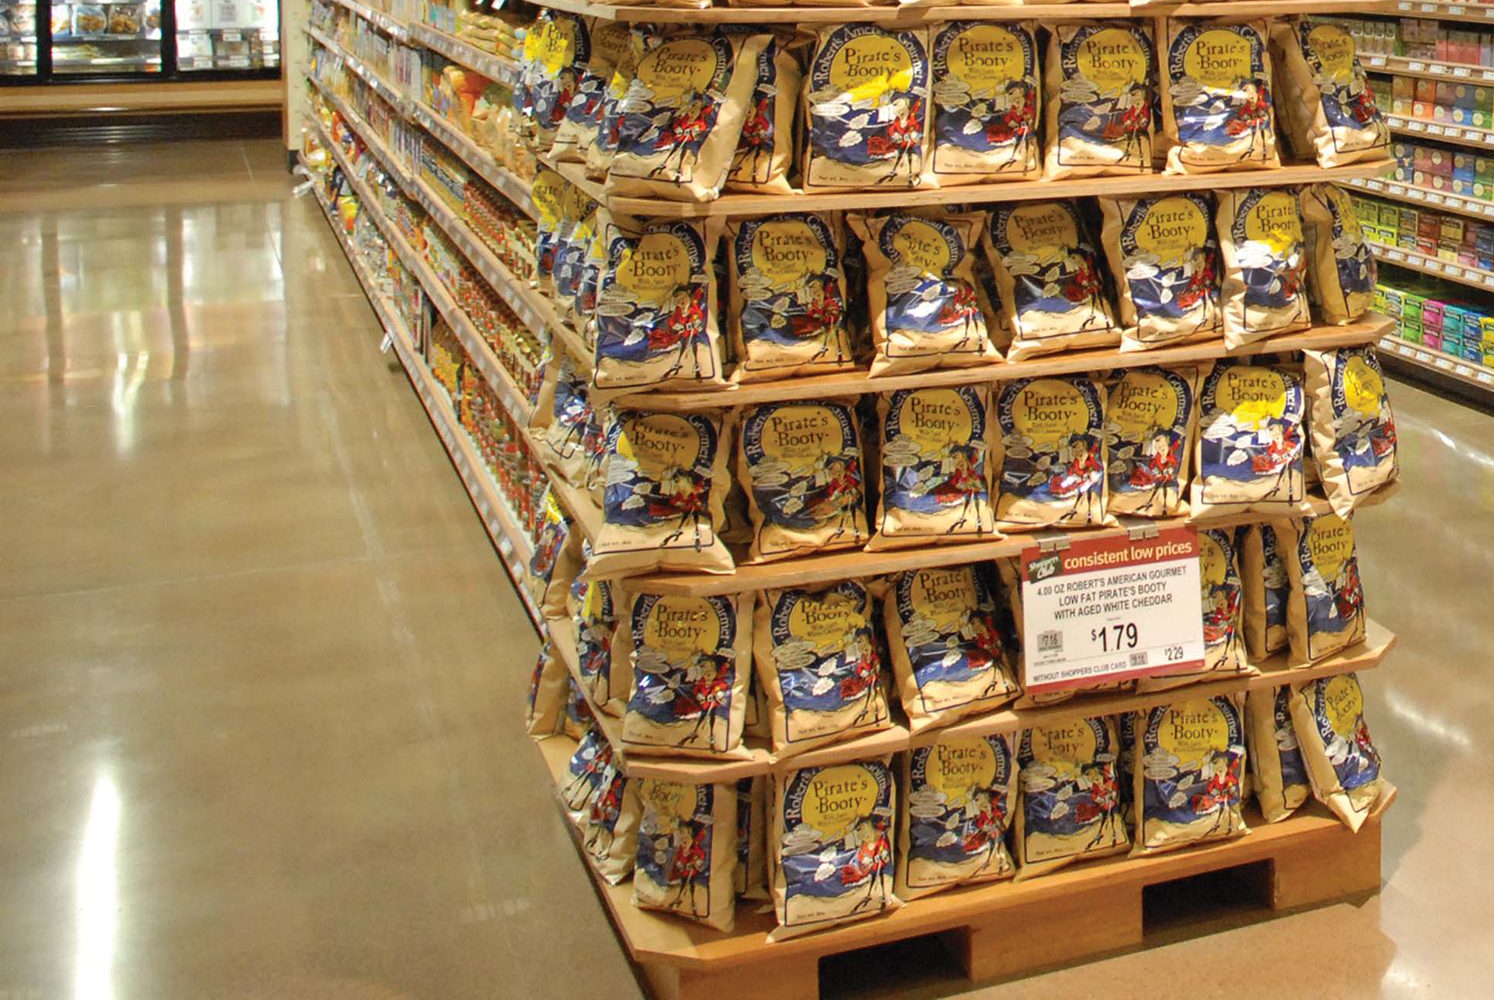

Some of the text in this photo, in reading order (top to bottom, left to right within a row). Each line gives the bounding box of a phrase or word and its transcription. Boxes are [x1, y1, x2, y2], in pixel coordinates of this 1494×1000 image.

[959, 36, 1013, 52] Pirate's
[1086, 39, 1136, 56] Pirate's
[1196, 40, 1245, 56] Pirate's
[655, 46, 708, 63] Pirate's
[844, 45, 900, 64] Pirate's
[964, 54, 1007, 70] Booty
[654, 61, 697, 76] Booty
[848, 64, 893, 80] Booty
[1091, 56, 1134, 74] Booty
[1200, 56, 1239, 71] Booty
[1013, 210, 1065, 229] Pirate's
[1146, 208, 1194, 227] Pirate's
[758, 228, 812, 247] Pirate's
[1022, 227, 1064, 242] Booty
[1151, 225, 1191, 240] Booty
[630, 243, 680, 262] Pirate's
[762, 245, 809, 263] Booty
[633, 260, 677, 279] Booty
[1227, 374, 1276, 390] Pirate's
[1024, 390, 1078, 407] Pirate's
[1118, 381, 1168, 401] Pirate's
[1231, 388, 1272, 402] Booty
[910, 397, 961, 416] Pirate's
[1027, 407, 1074, 423] Booty
[1117, 399, 1161, 415] Booty
[771, 416, 828, 434] Pirate's
[915, 414, 956, 430] Booty
[633, 434, 681, 453] Booty
[778, 432, 825, 448] Booty
[1065, 543, 1192, 569] consistent low prices
[1054, 584, 1065, 593] OZ
[1067, 579, 1105, 592] ROBERT'S
[1107, 570, 1147, 585] AMERICAN
[1150, 566, 1186, 579] GOURMET
[1059, 582, 1167, 606] LOW FAT PIRATE'S BOOTY
[655, 605, 708, 623] Pirate's
[1054, 594, 1172, 620] WITH AGED WHITE CHEDDAR
[659, 622, 703, 639] Booty
[1034, 671, 1059, 682] WITHOUT
[1062, 667, 1092, 678] SHOPPERS
[1094, 664, 1108, 674] CLUB
[1111, 661, 1127, 671] CARD
[1169, 708, 1218, 725] Pirate's
[1174, 725, 1214, 741] Booty
[937, 743, 987, 761] Pirate's
[942, 760, 980, 777] Booty
[812, 776, 868, 798] Pirate's
[819, 796, 863, 815] Booty
